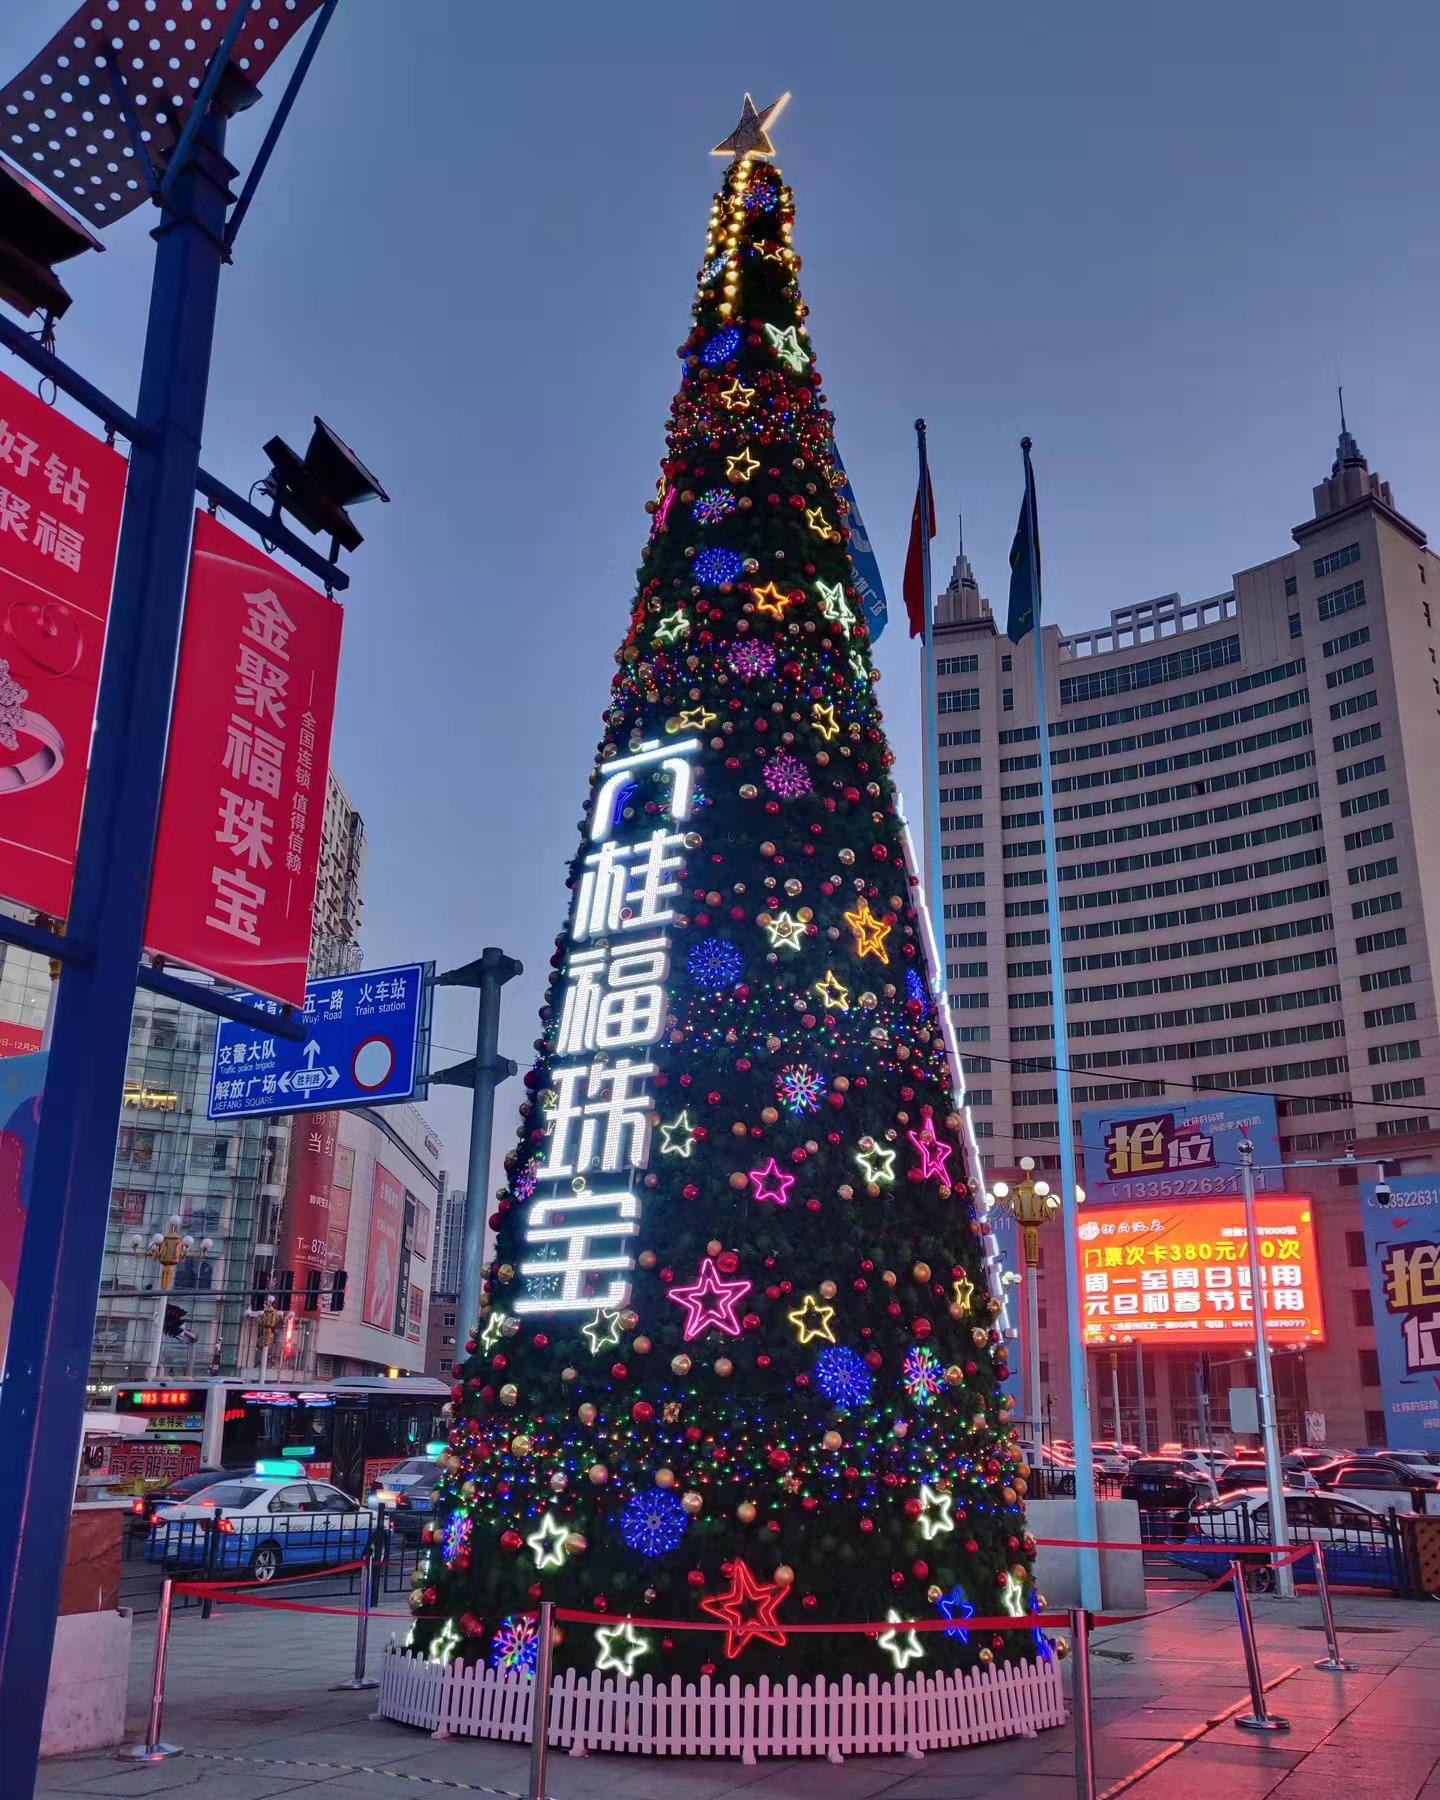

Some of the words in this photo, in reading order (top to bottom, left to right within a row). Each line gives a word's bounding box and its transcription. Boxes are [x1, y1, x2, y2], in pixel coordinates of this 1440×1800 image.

[295, 711, 317, 790] 全国连锁
[205, 588, 297, 946] 金聚福珠宝
[286, 791, 309, 875] 值得信赖
[303, 988, 344, 1014] 五一路
[358, 978, 407, 1004] 火车站
[301, 1013, 320, 1025] Wuyi
[323, 1009, 343, 1021] Road
[355, 1004, 375, 1016] Train
[378, 1001, 406, 1013] station
[0, 1038, 40, 1053] 日-12月25
[218, 1038, 276, 1066] 交警大队
[219, 1064, 235, 1076] Traffic
[237, 1063, 254, 1076] police
[255, 1060, 275, 1072] brigade
[296, 1072, 321, 1086] 胜利路
[214, 1073, 277, 1100] 解放广场
[213, 1098, 242, 1111] JIEFANG
[244, 1095, 274, 1107] SQUARE
[1108, 1118, 1212, 1175] 抢位
[1123, 1171, 1267, 1200] 1335226311
[1085, 1239, 1301, 1268] 门票次卡380元/0次
[1085, 1265, 1303, 1294] 周一至周日通用
[111, 1453, 198, 1478] 冠军服装城
